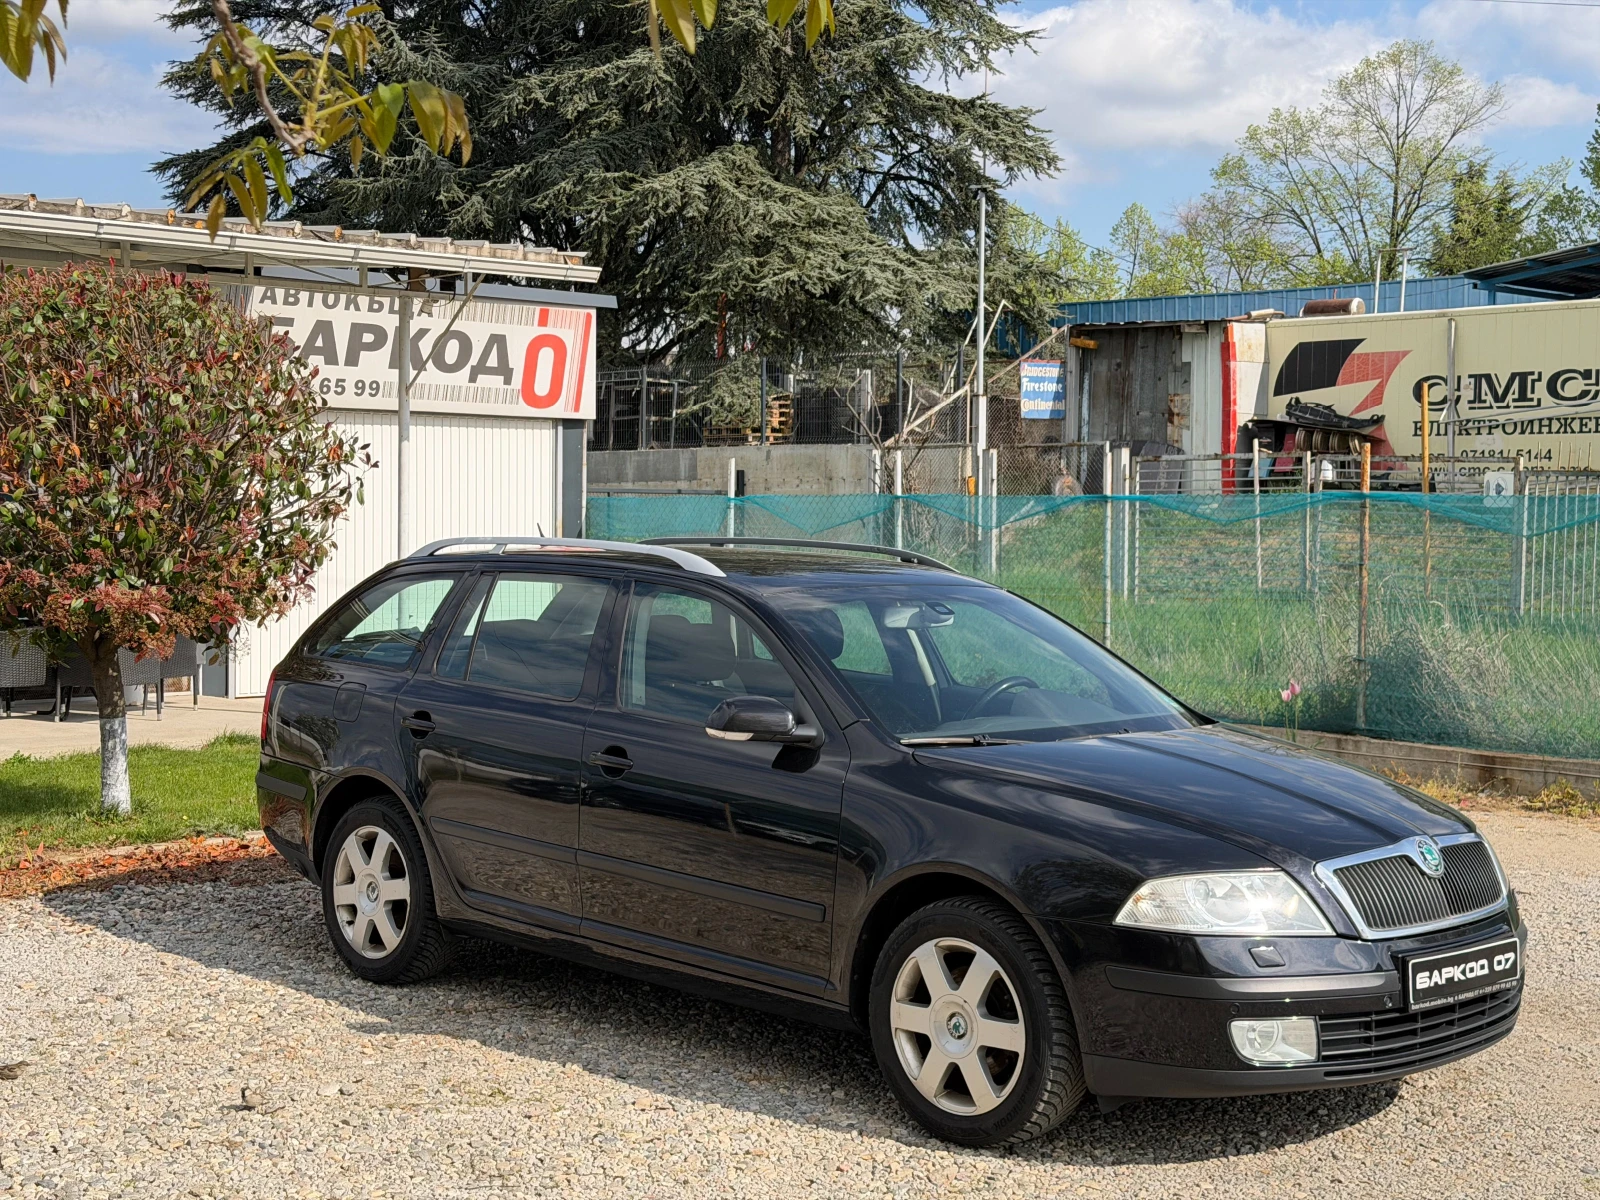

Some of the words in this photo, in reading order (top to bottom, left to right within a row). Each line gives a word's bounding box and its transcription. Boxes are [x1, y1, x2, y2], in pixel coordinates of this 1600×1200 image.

[257, 314, 515, 386] БАРКОД
[319, 377, 346, 396] 65
[353, 379, 381, 398] 99
[1022, 377, 1063, 392] Firestone
[1021, 398, 1065, 412] Continental
[1416, 958, 1489, 990] БАРКОД
[1493, 951, 1516, 972] 07
